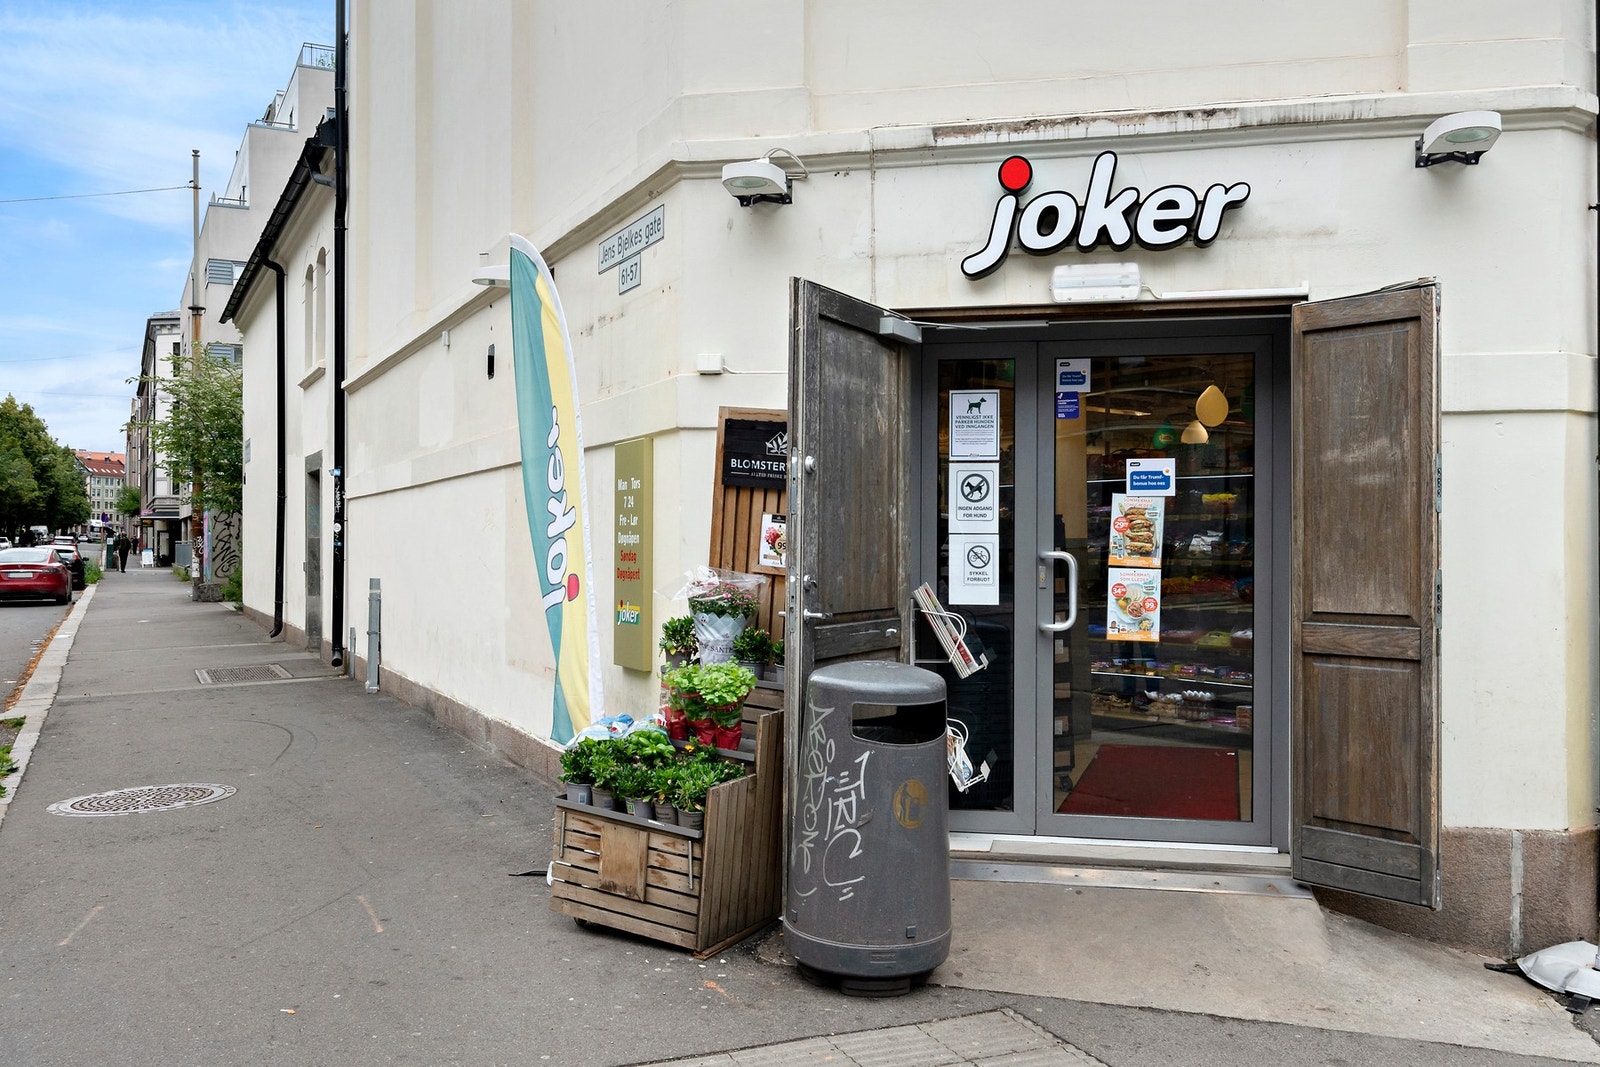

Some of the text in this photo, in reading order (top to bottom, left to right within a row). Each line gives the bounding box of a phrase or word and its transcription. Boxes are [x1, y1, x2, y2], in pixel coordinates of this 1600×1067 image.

[961, 151, 1251, 280] joker
[600, 216, 661, 264] Jens Bjelkes gate
[621, 262, 638, 285] 61-57
[731, 459, 787, 472] BLOMSTER
[617, 477, 641, 491] Man Tors
[542, 406, 579, 611] joker
[619, 514, 627, 526] Fre
[620, 550, 637, 564] Søndag
[617, 600, 640, 626] joker
